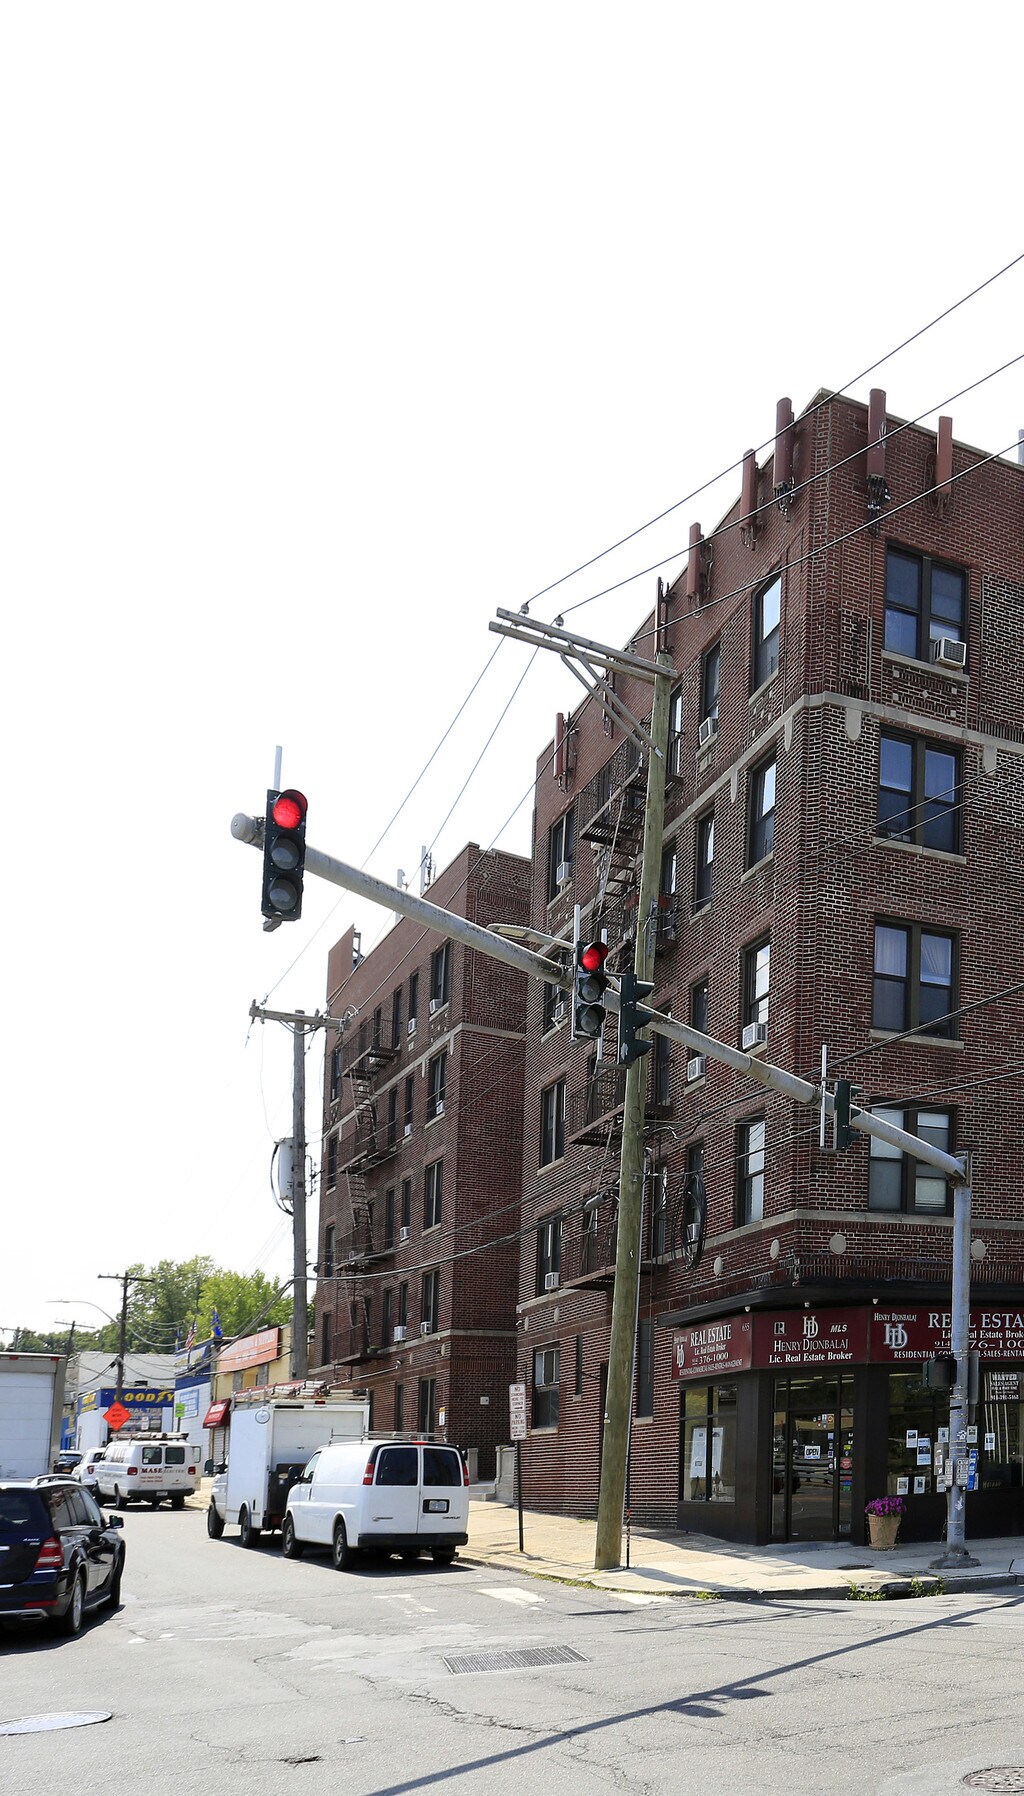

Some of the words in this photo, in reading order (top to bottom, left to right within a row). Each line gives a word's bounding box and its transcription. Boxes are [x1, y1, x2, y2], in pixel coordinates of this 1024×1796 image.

[928, 1313, 976, 1328] REL
[741, 1322, 750, 1332] 655
[830, 1324, 848, 1333] MLS
[690, 1330, 707, 1347] REAL
[707, 1324, 732, 1344] ESTATE
[980, 1330, 1003, 1339] Estate
[774, 1340, 802, 1352] HENRY
[803, 1339, 848, 1352] DJONBALAJ
[698, 1351, 729, 1365] 376-1000
[769, 1354, 783, 1363] Lic.
[785, 1353, 801, 1362] Real
[803, 1352, 826, 1361] Estate
[828, 1351, 854, 1360] Broker
[806, 1448, 820, 1456] OPEN
